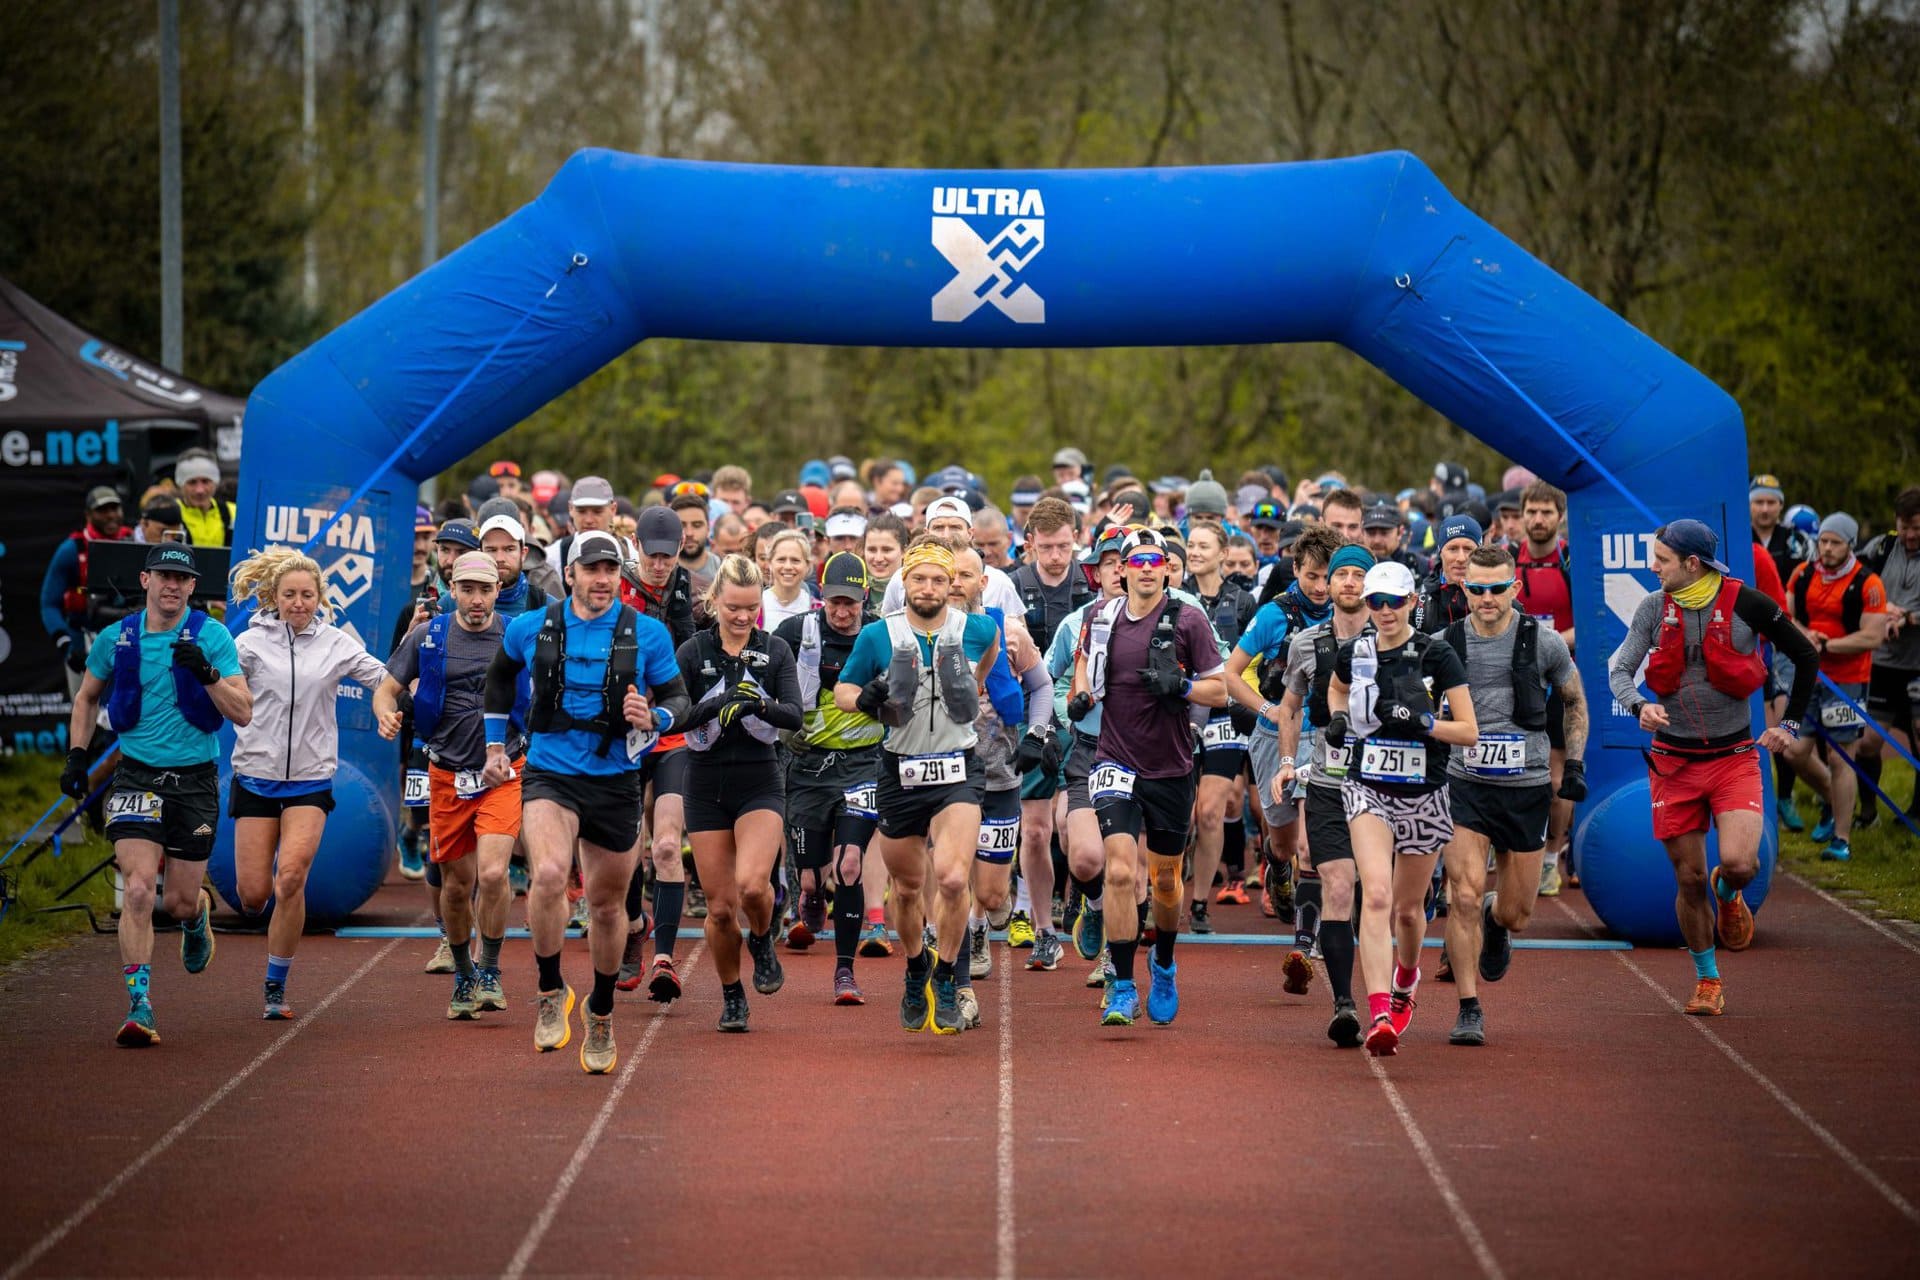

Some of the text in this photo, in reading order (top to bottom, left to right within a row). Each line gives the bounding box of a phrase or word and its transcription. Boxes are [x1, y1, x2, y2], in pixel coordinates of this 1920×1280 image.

[932, 187, 1045, 216] ULTRA
[265, 505, 375, 554] ULTRA
[161, 550, 190, 565] HOKA
[1602, 534, 1657, 569] ULT
[1835, 707, 1857, 723] 590
[1379, 749, 1404, 772] 251
[1480, 743, 1507, 765] 274
[920, 760, 945, 782] 291
[1096, 769, 1116, 790] 145
[407, 778, 422, 797] 215
[119, 795, 144, 813] 241
[861, 791, 878, 810] 30
[993, 827, 1015, 848] 282
